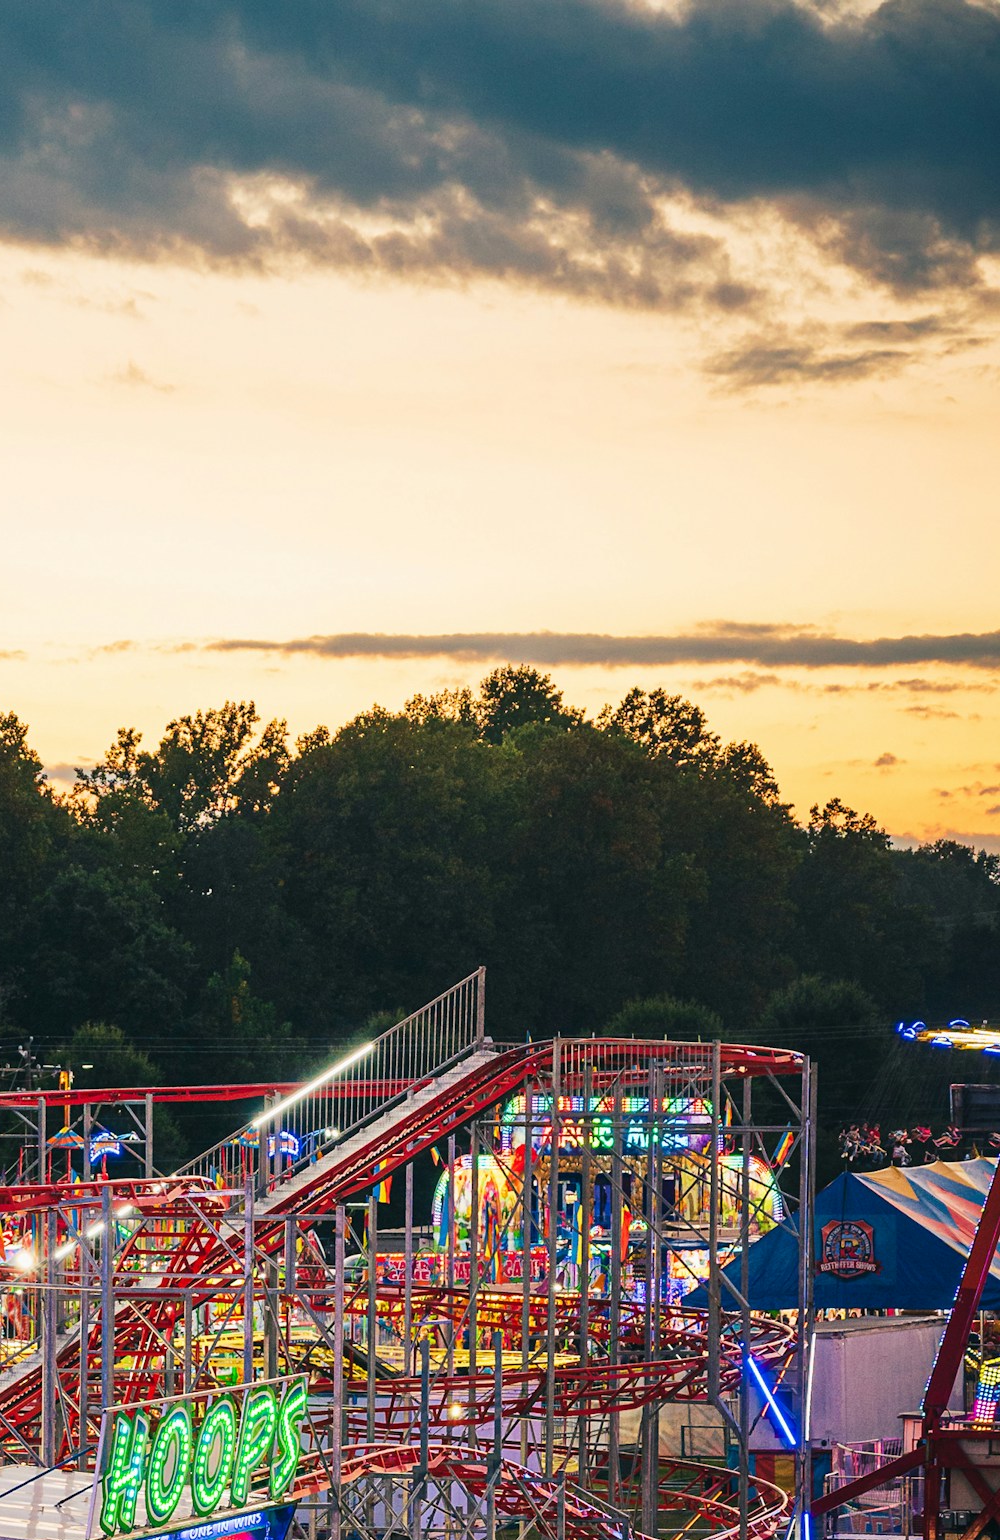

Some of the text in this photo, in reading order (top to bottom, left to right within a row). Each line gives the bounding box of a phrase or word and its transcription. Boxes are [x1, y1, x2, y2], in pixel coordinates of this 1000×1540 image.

[389, 1259, 430, 1270] WAER
[855, 1261, 876, 1272] SHOWS
[100, 1376, 308, 1537] HOOPS
[189, 1512, 262, 1540] ONE IN WINS
